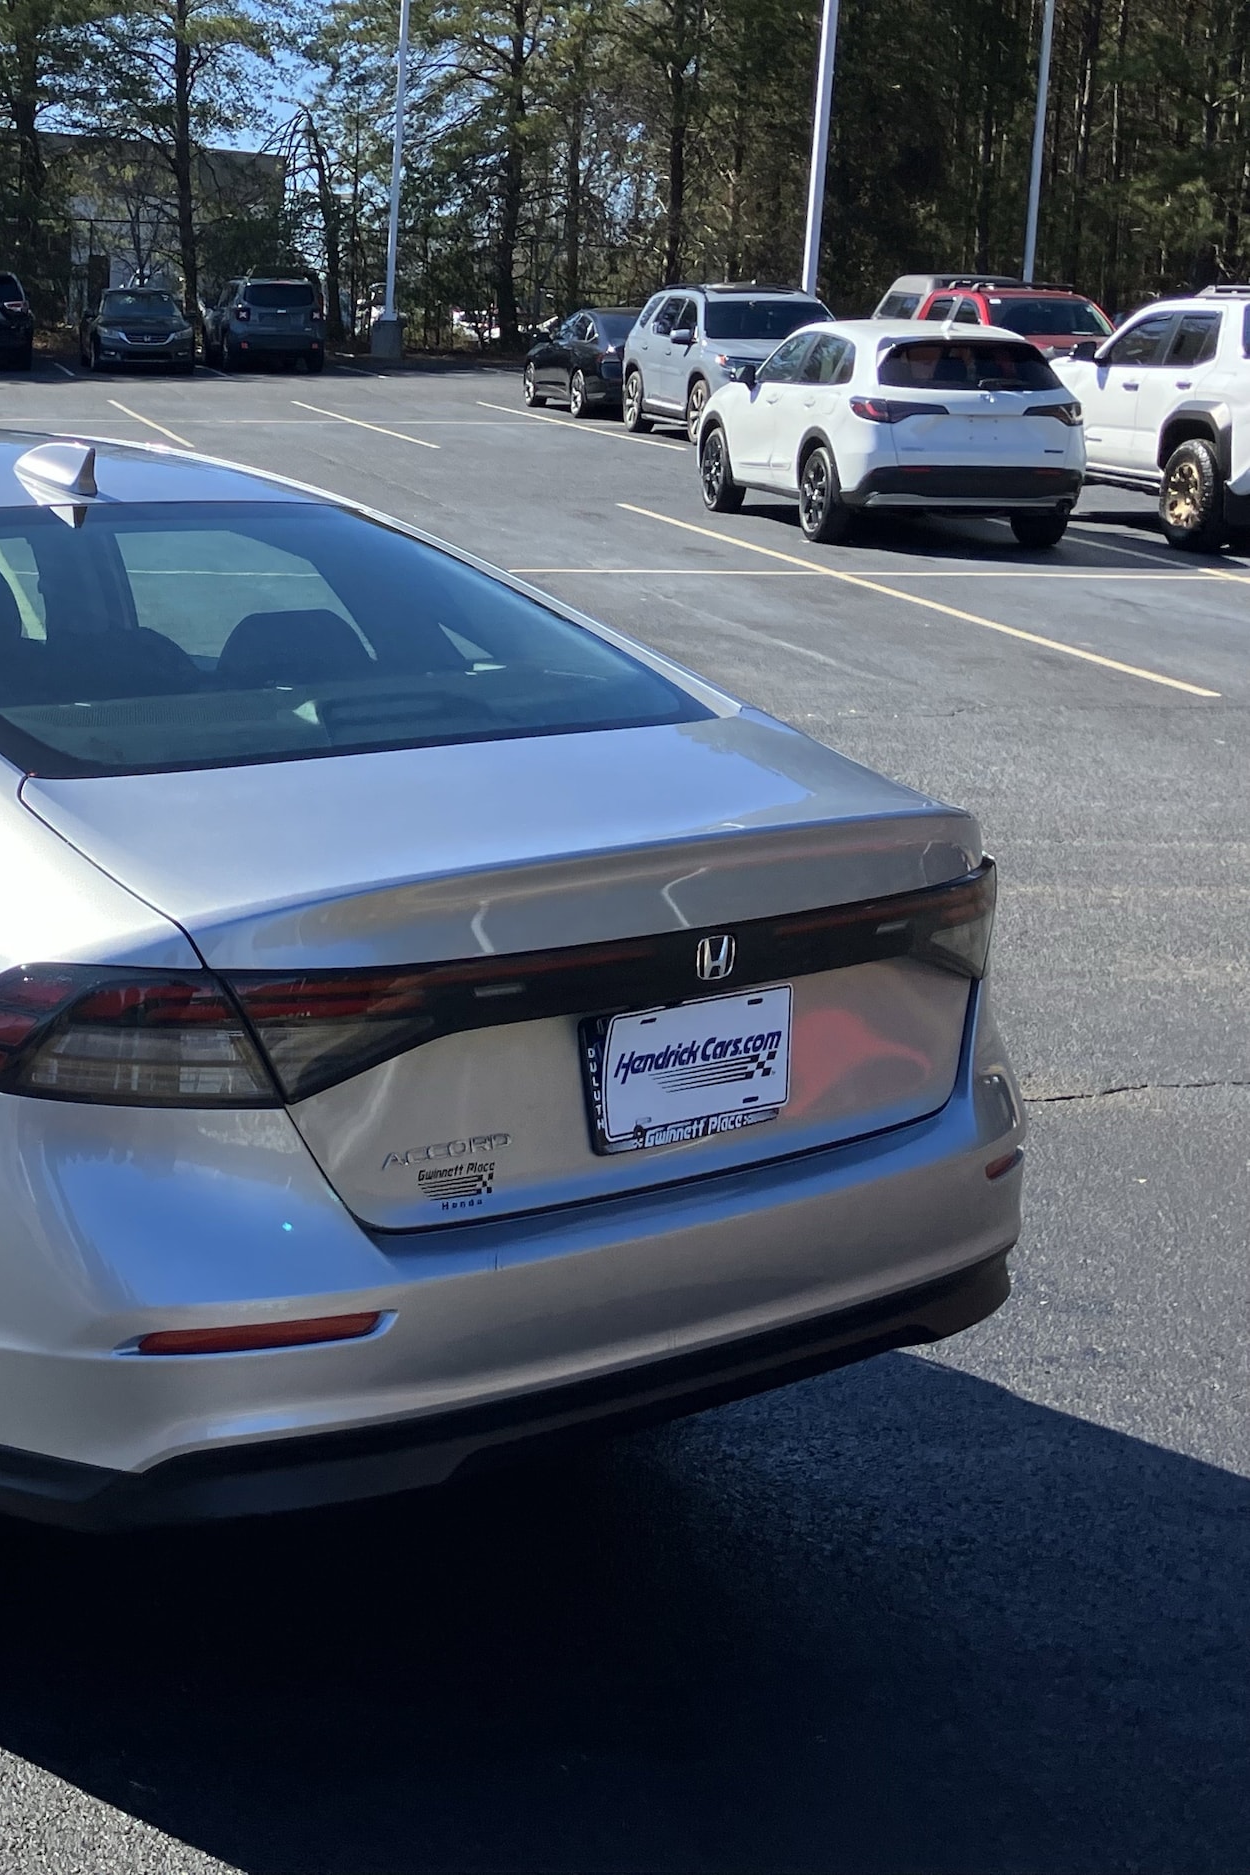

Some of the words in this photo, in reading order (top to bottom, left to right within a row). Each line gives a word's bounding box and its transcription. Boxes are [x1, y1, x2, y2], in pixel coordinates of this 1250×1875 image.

[587, 1047, 606, 1130] DULUTH
[381, 1133, 511, 1170] ACCORD
[417, 1165, 464, 1181] Gwinnett
[441, 1199, 483, 1211] Honda
